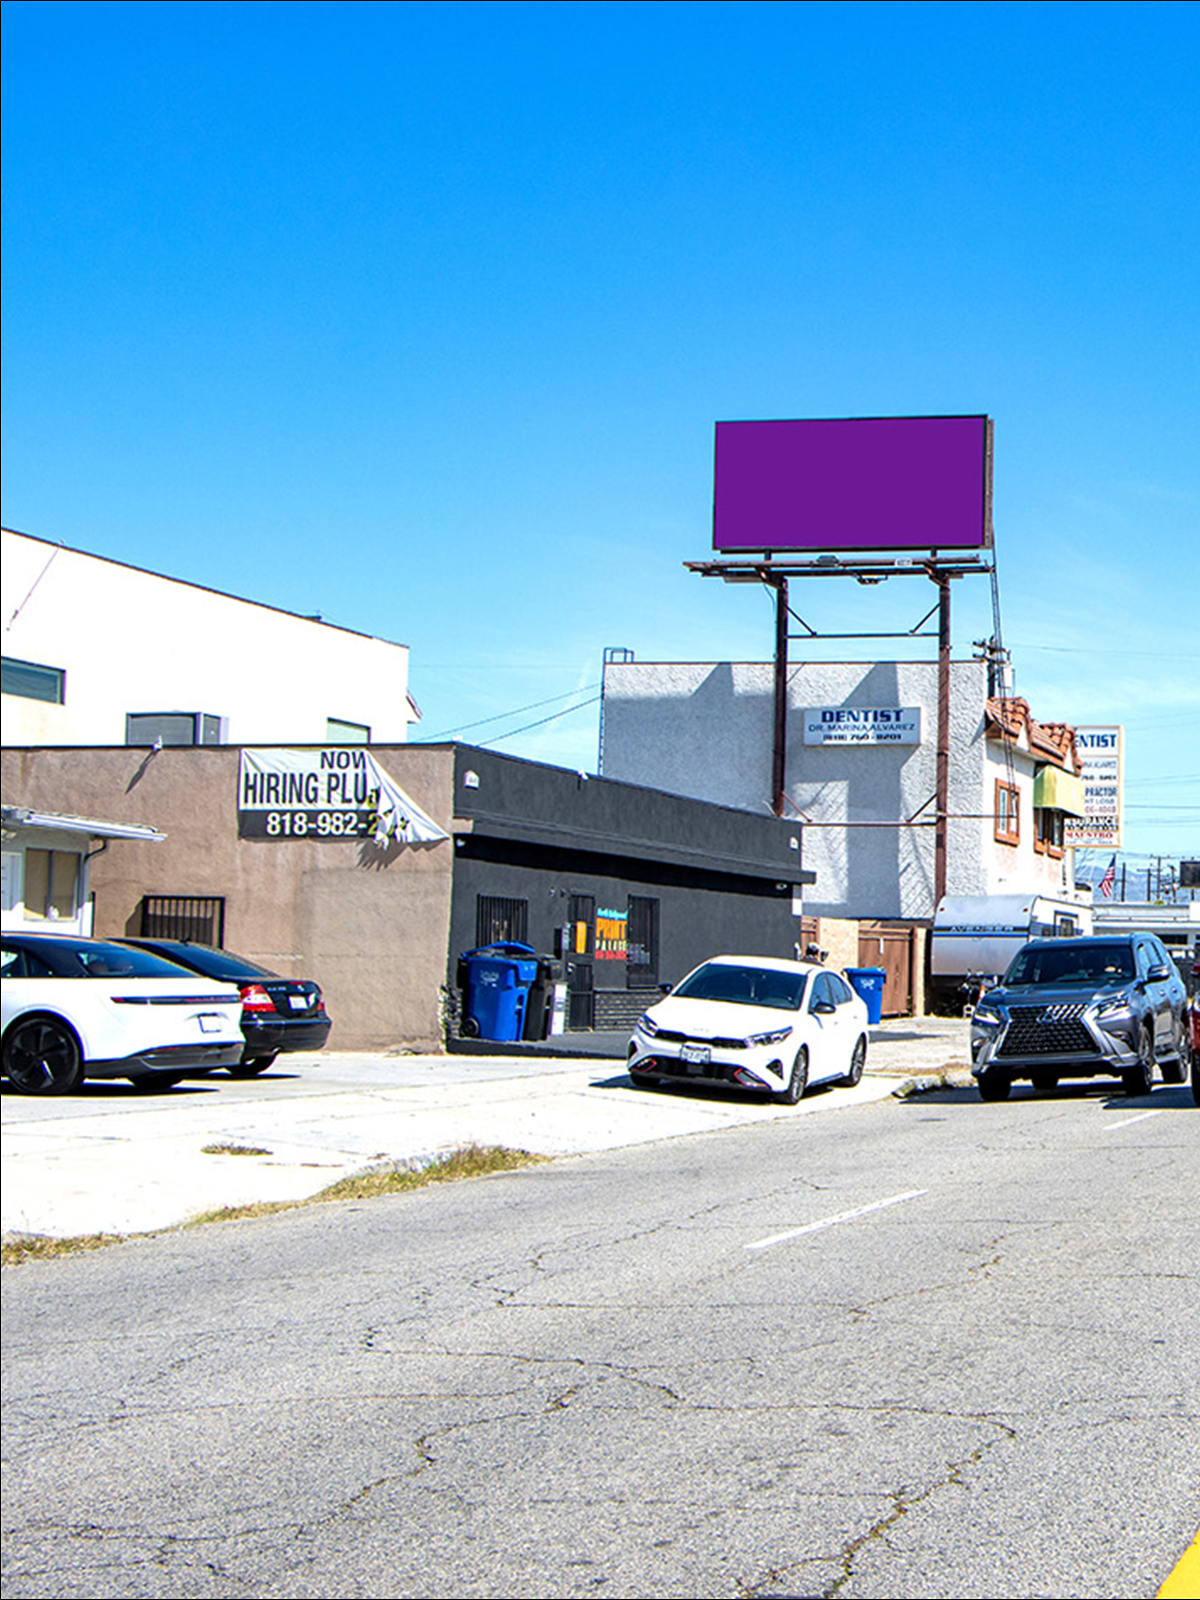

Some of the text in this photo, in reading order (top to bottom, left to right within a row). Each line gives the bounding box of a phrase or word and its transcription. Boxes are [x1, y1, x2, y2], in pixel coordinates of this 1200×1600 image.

[821, 709, 903, 723] DENTIST
[808, 723, 915, 732] DR. MARINA ALVAREZ
[1075, 734, 1117, 748] ENTIST
[244, 772, 368, 805] HIRING PLU
[1085, 787, 1117, 796] PRACTOR
[266, 812, 379, 836] 818-982-2
